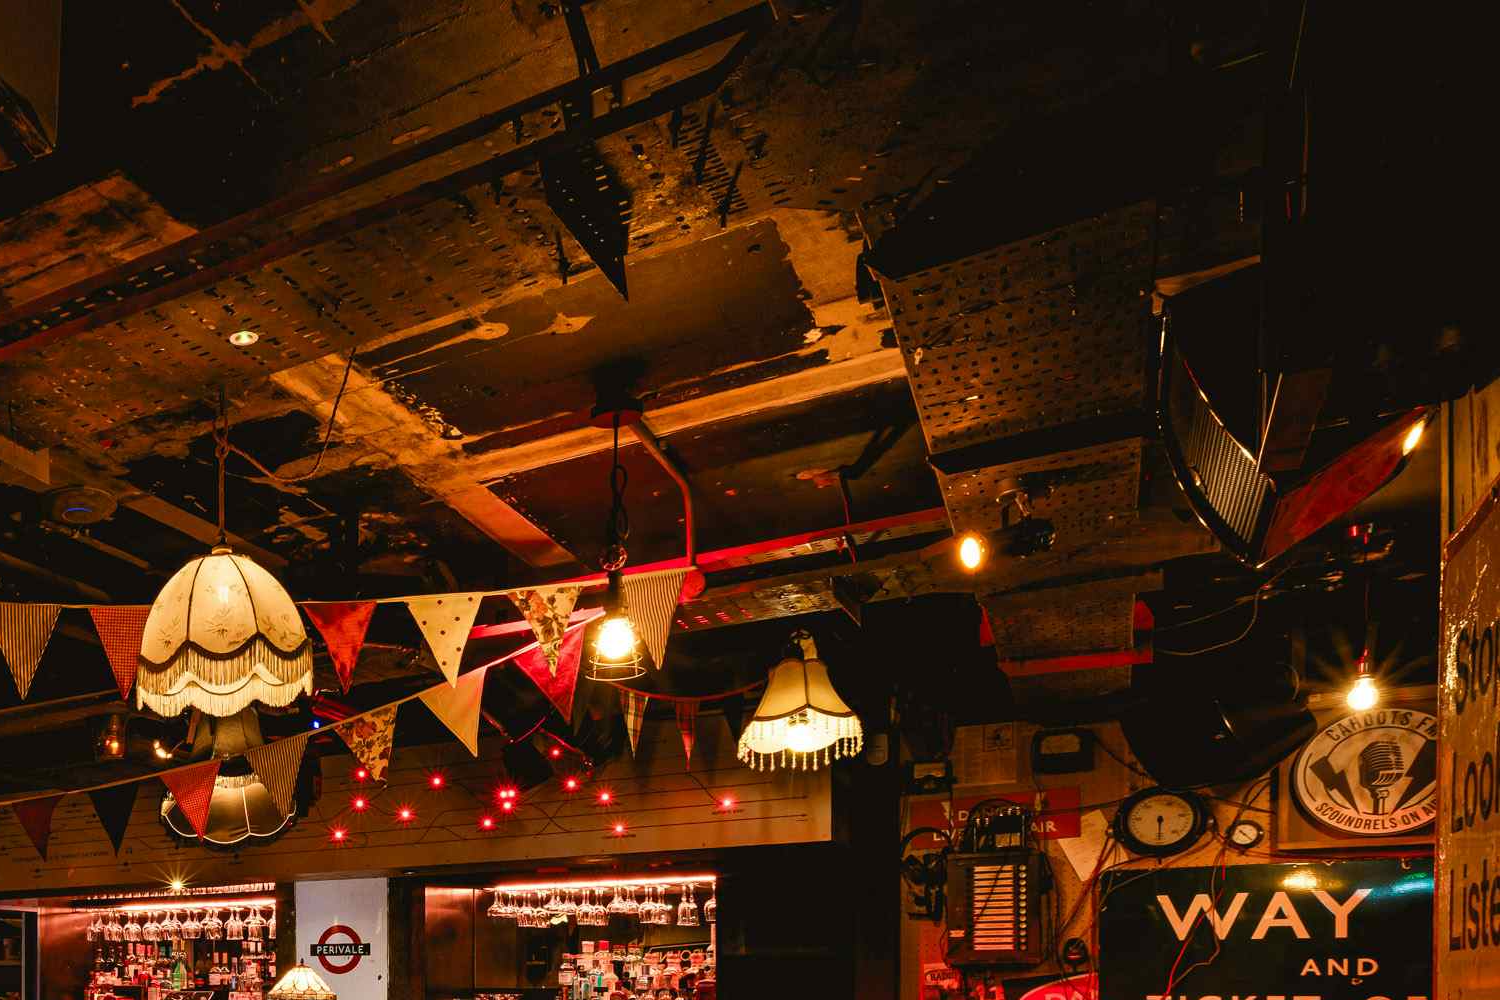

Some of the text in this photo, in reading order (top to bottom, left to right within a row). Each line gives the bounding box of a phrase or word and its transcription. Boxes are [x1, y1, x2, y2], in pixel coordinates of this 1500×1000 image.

[1325, 711, 1413, 741] CAHOOTS
[1315, 799, 1437, 830] SCOUNDRELS ON AI
[1156, 888, 1374, 942] WAY
[316, 944, 365, 955] PERIVALE
[1300, 958, 1379, 977] AND
